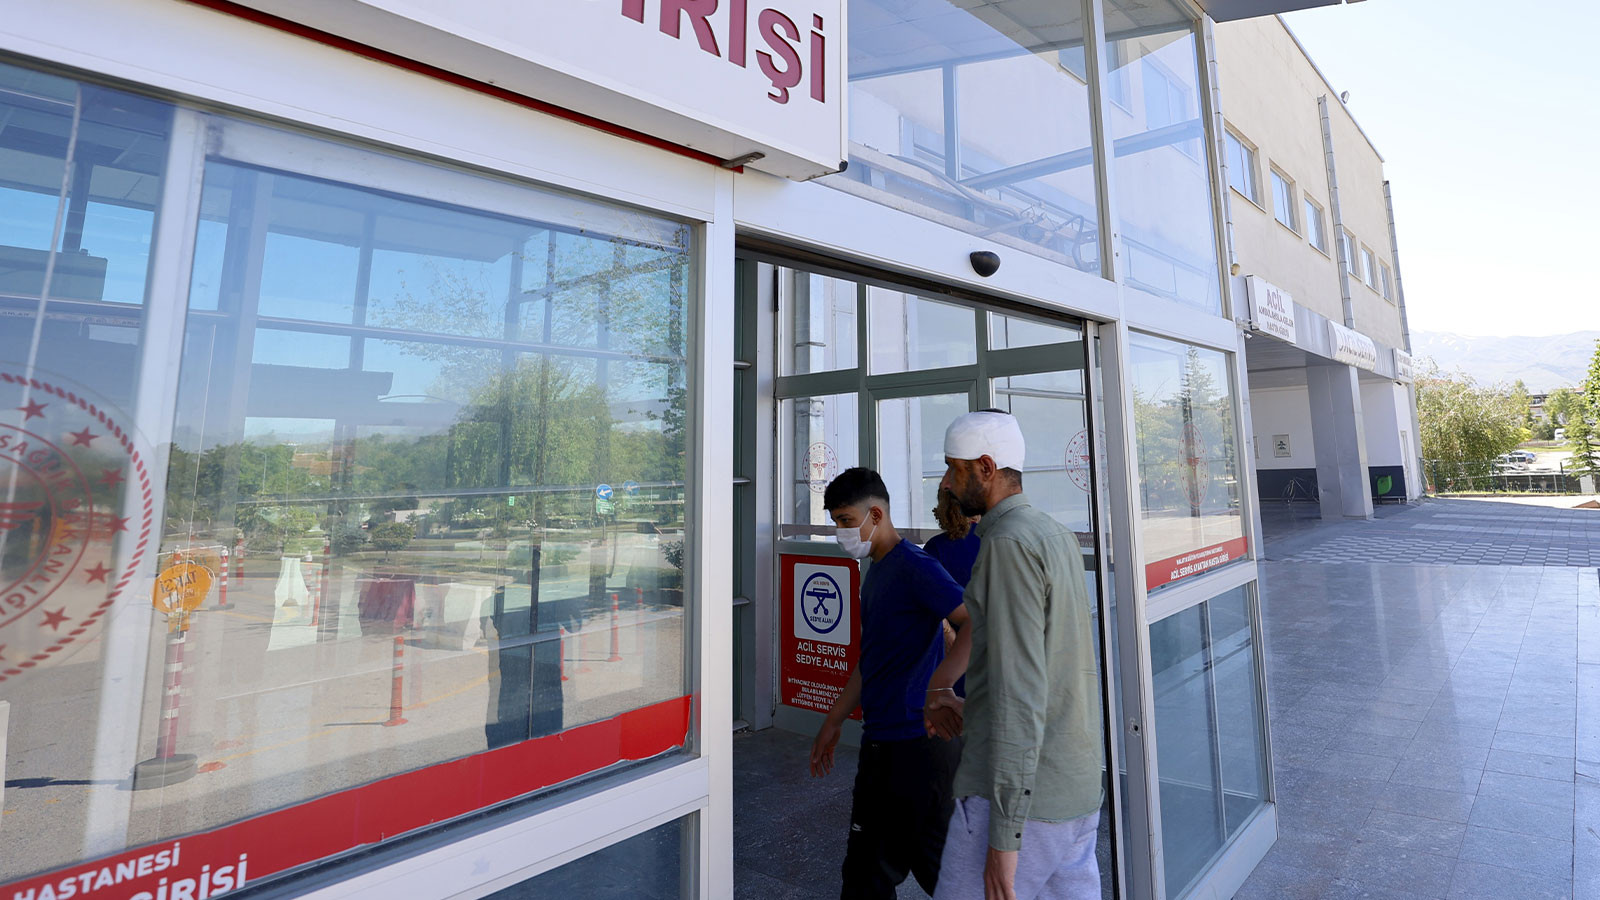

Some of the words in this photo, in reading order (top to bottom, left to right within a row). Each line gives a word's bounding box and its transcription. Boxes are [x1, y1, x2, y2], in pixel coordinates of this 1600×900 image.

[1266, 288, 1286, 314] ACİL
[797, 641, 815, 653] ACİL
[817, 643, 846, 657] SERVİS
[796, 654, 822, 667] SEDYE
[823, 658, 848, 671] ALANI
[13, 842, 181, 900] HASTANESİ
